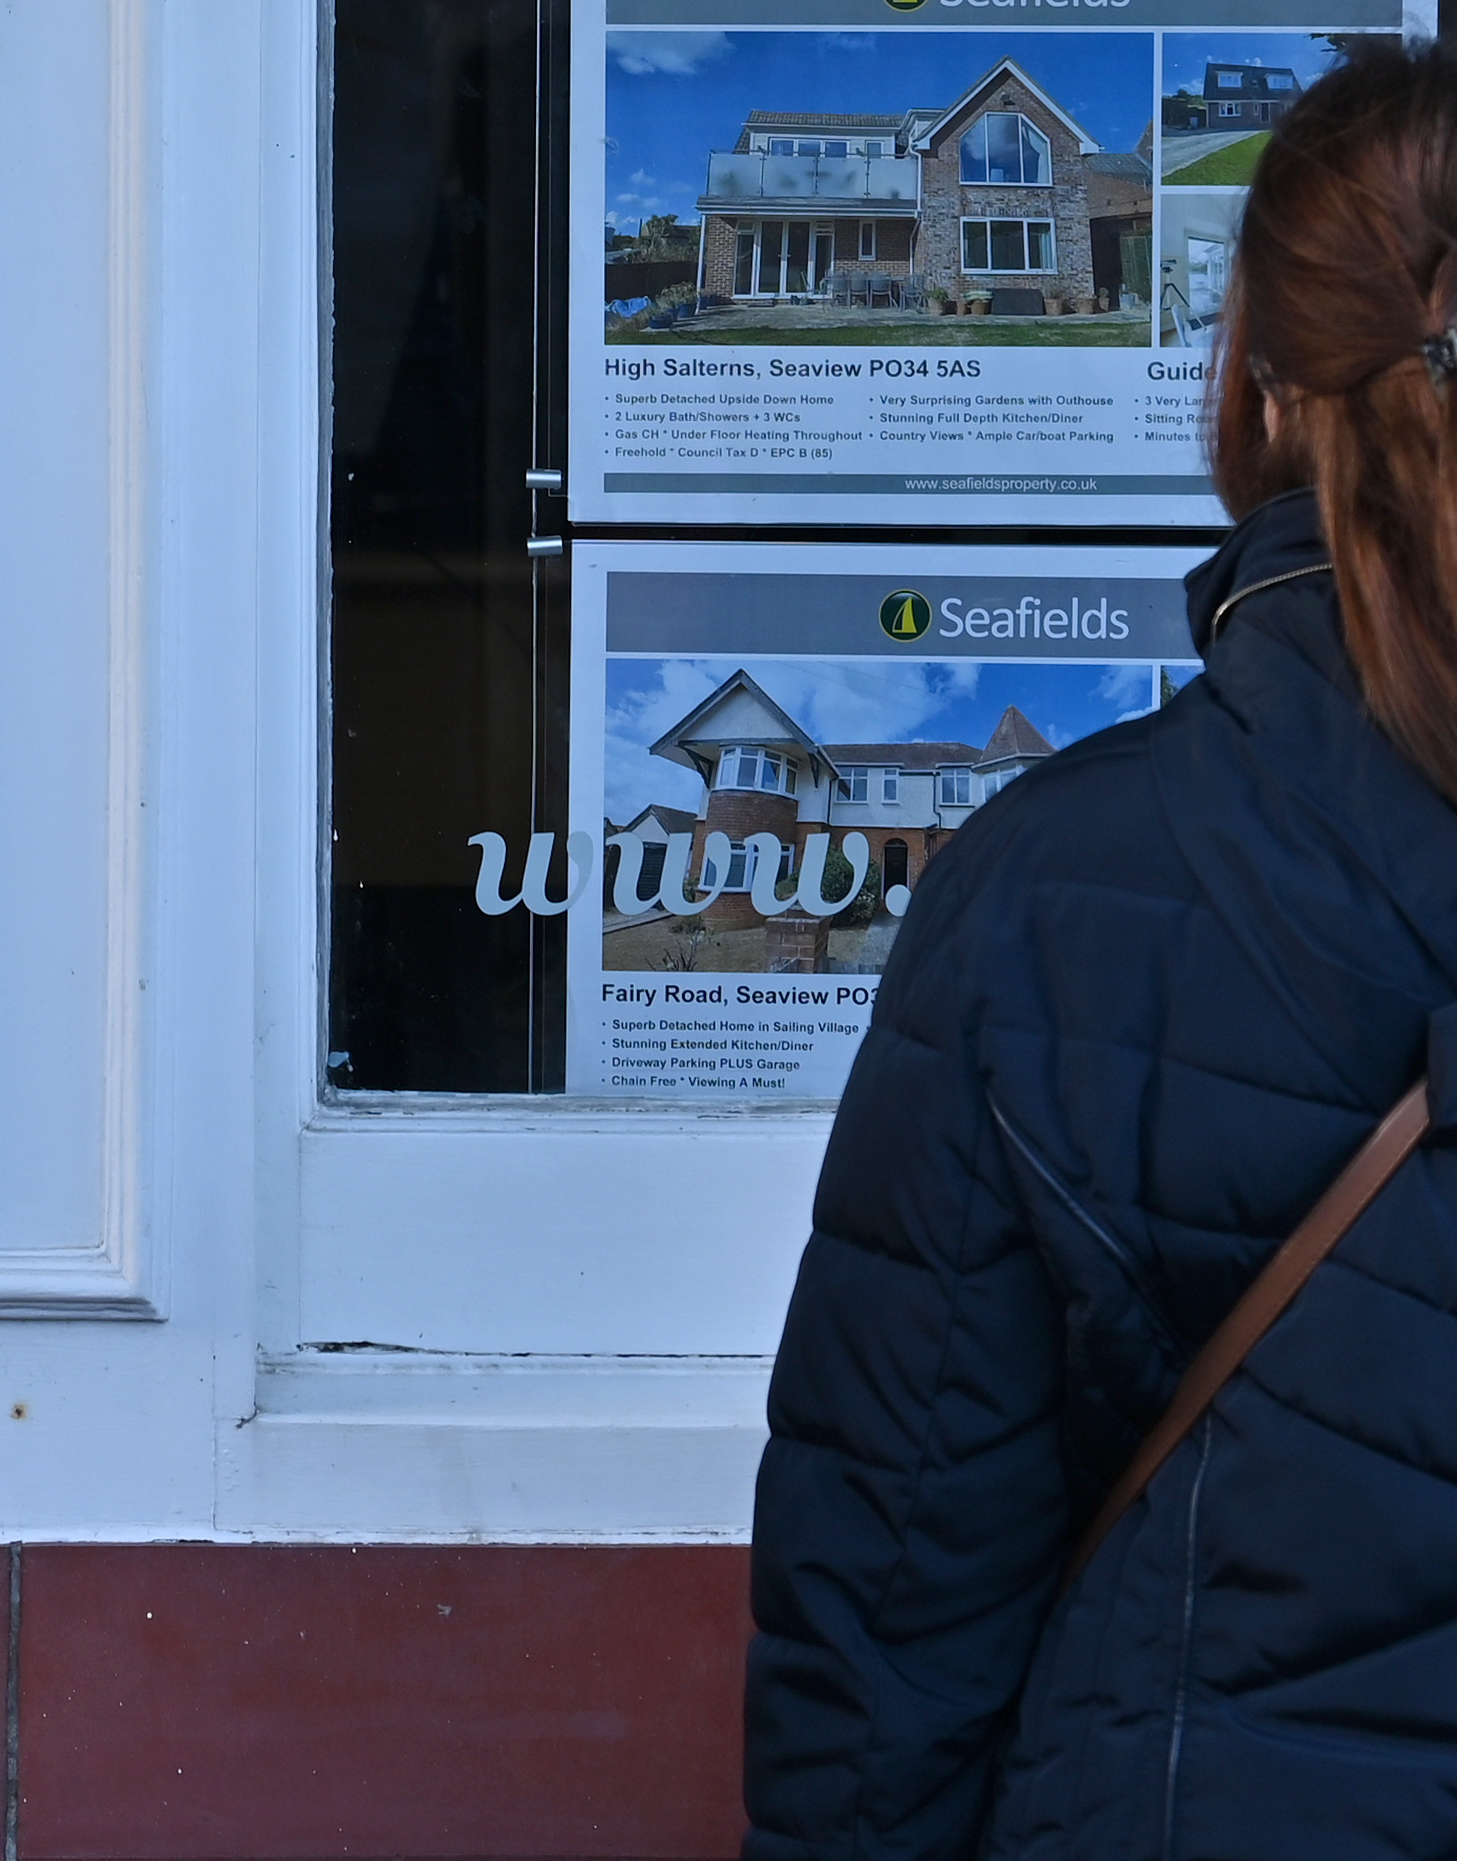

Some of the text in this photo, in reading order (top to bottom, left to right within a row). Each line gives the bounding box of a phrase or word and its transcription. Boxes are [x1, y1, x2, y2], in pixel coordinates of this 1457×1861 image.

[604, 357, 981, 381] High Salterns, Seaview PO34 5AS
[879, 412, 1083, 425] Stunning Full Depth Kitchen/Diner
[904, 476, 1097, 493] www.seafieldsproperty.co.uk
[938, 596, 1130, 639] Seafields
[601, 983, 657, 1007] Fairy
[664, 984, 728, 1007] Road,
[736, 985, 829, 1005] Seaview
[611, 1037, 814, 1052] Stunning Extended Kitchen/Diner
